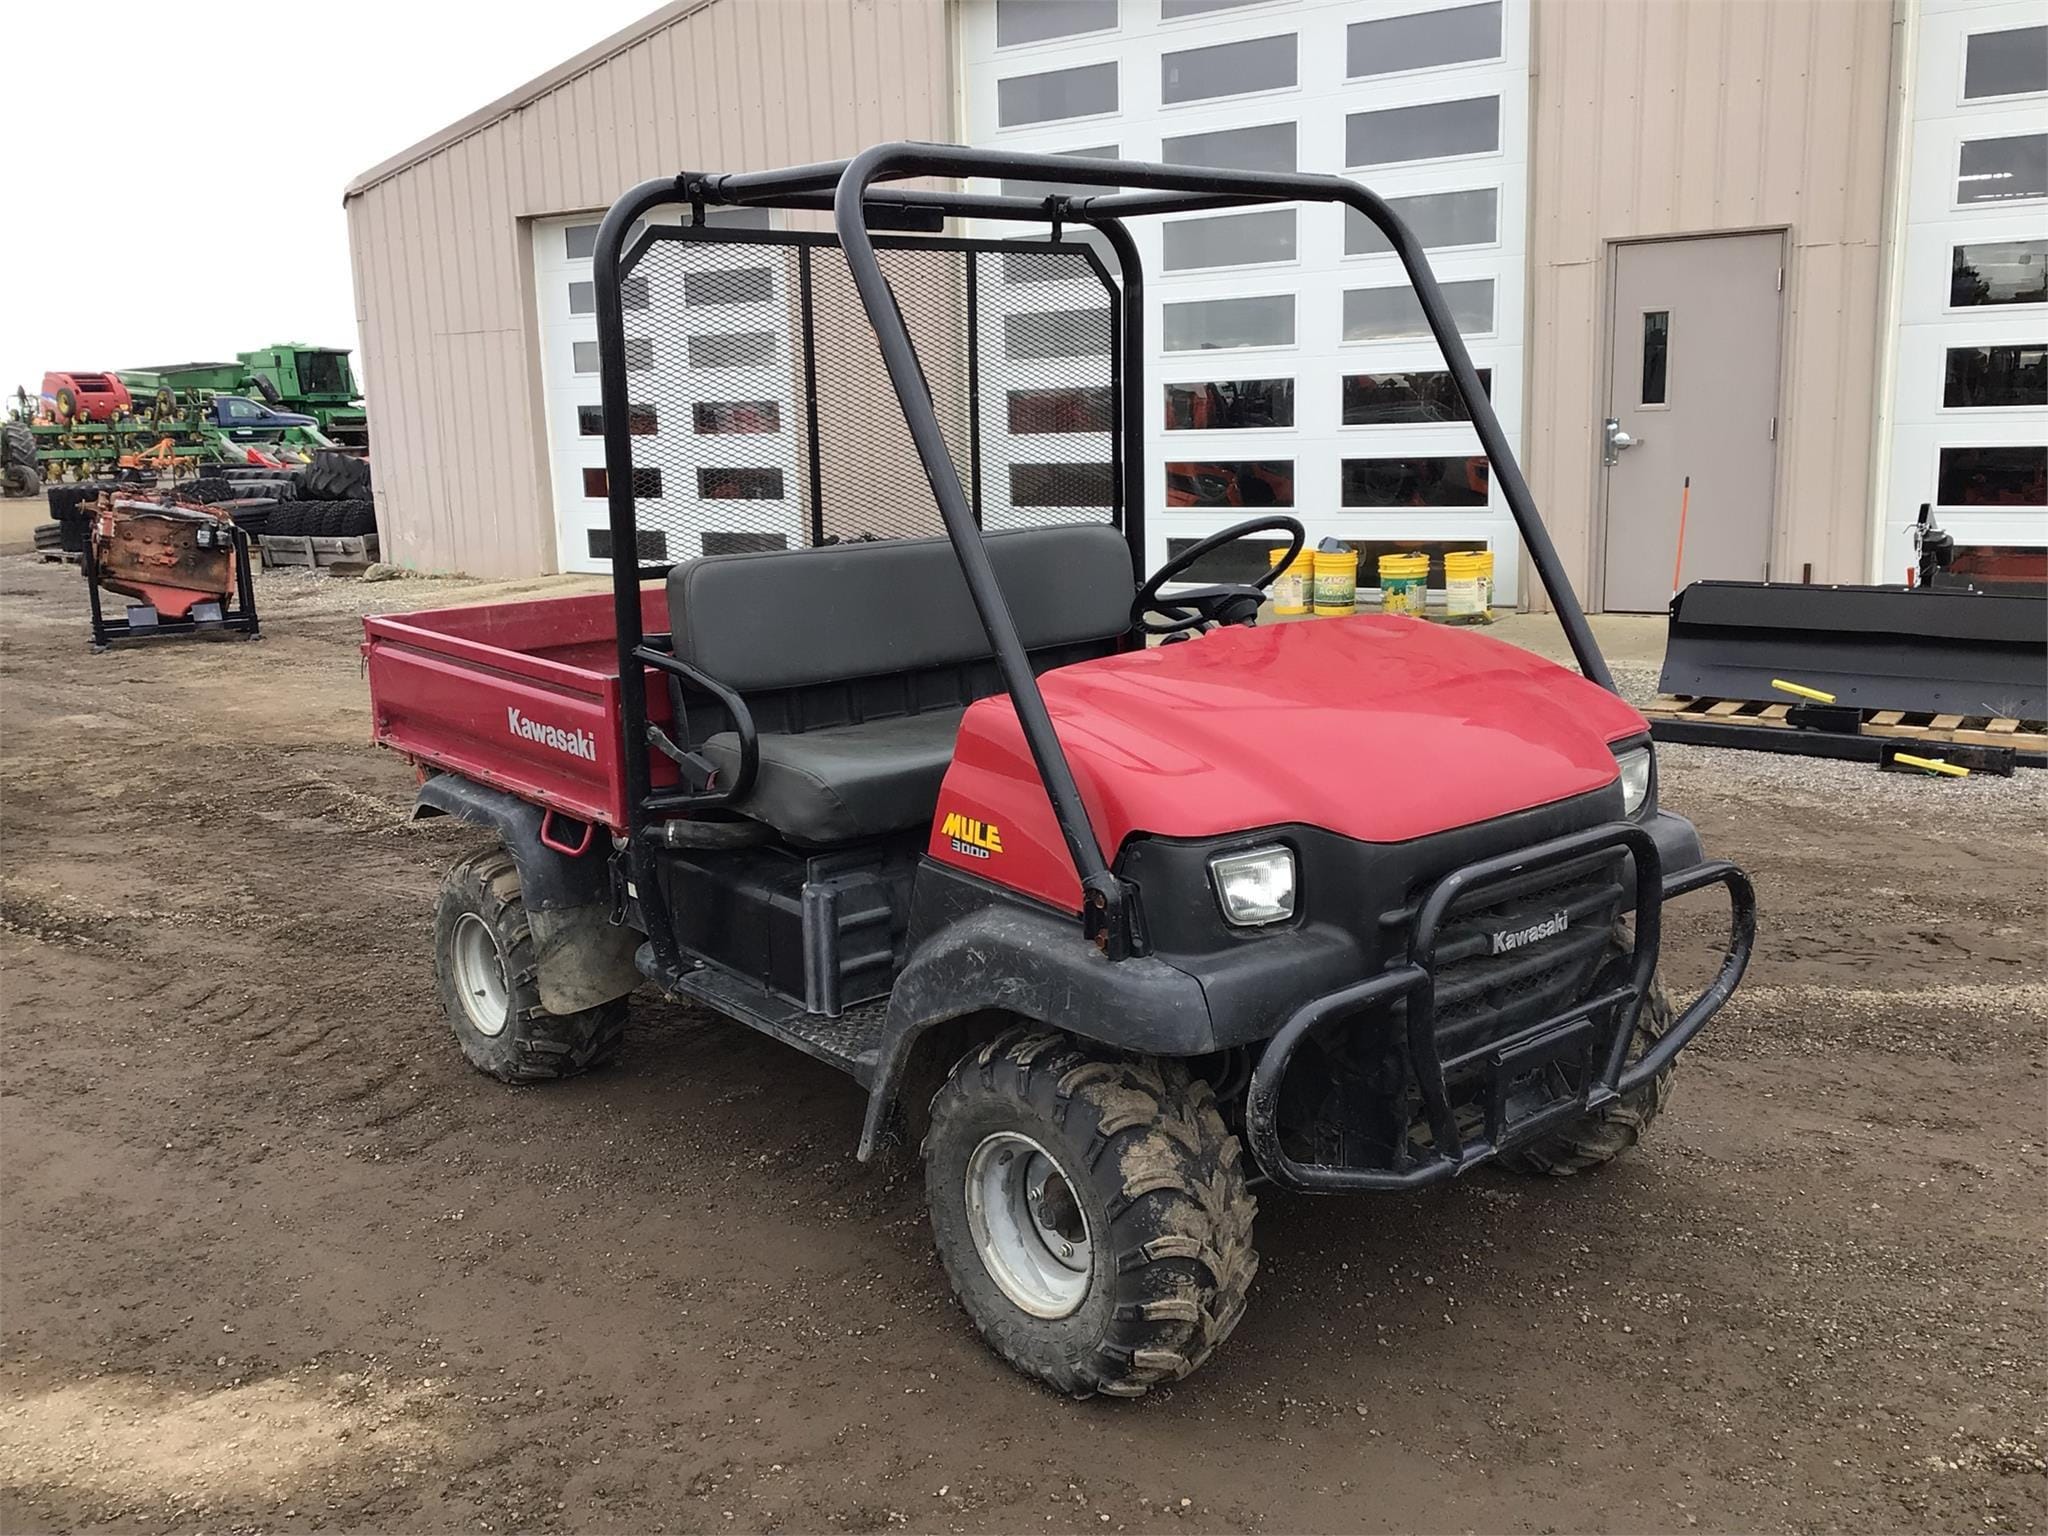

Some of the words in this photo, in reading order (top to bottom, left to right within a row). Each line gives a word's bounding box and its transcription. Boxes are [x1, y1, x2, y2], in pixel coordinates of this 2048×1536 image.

[507, 706, 596, 761] Kawasaki
[941, 812, 1003, 853] MULE
[952, 838, 989, 858] 3000
[1493, 909, 1568, 954] Kawasaki
